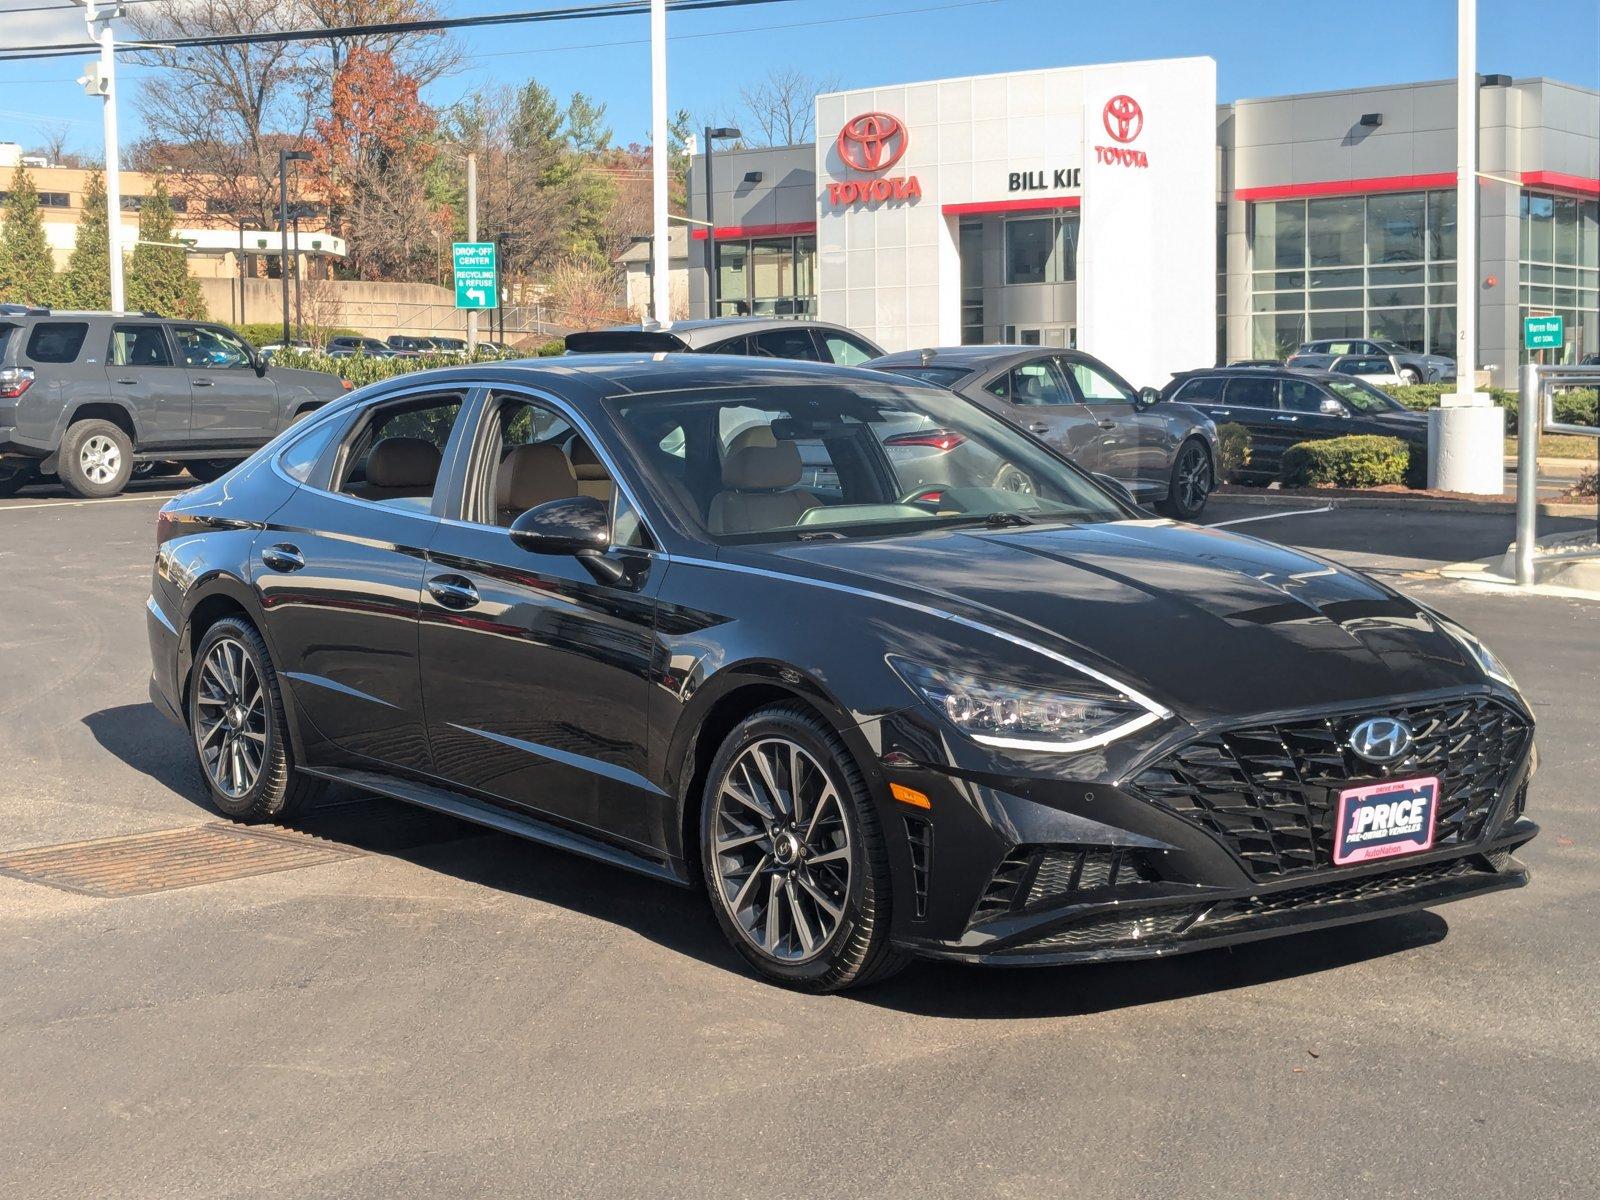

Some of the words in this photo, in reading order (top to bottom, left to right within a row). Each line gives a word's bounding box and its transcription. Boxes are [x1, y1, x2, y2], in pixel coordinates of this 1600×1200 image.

[1094, 145, 1149, 169] TOYOTA
[1008, 170, 1048, 191] BILL
[826, 175, 922, 207] TOYOTA
[455, 247, 492, 256] DROP-OFF
[459, 257, 490, 265] CENTER
[456, 271, 494, 279] RECYCLING
[466, 279, 493, 287] REFUSE
[1460, 330, 1465, 340] 2
[1375, 785, 1391, 794] DRIVE
[1349, 797, 1427, 834] 1PRICE
[1346, 829, 1388, 843] PRE-OWNED
[1388, 823, 1422, 836] VEHICLES
[1364, 846, 1402, 858] AutoNation
